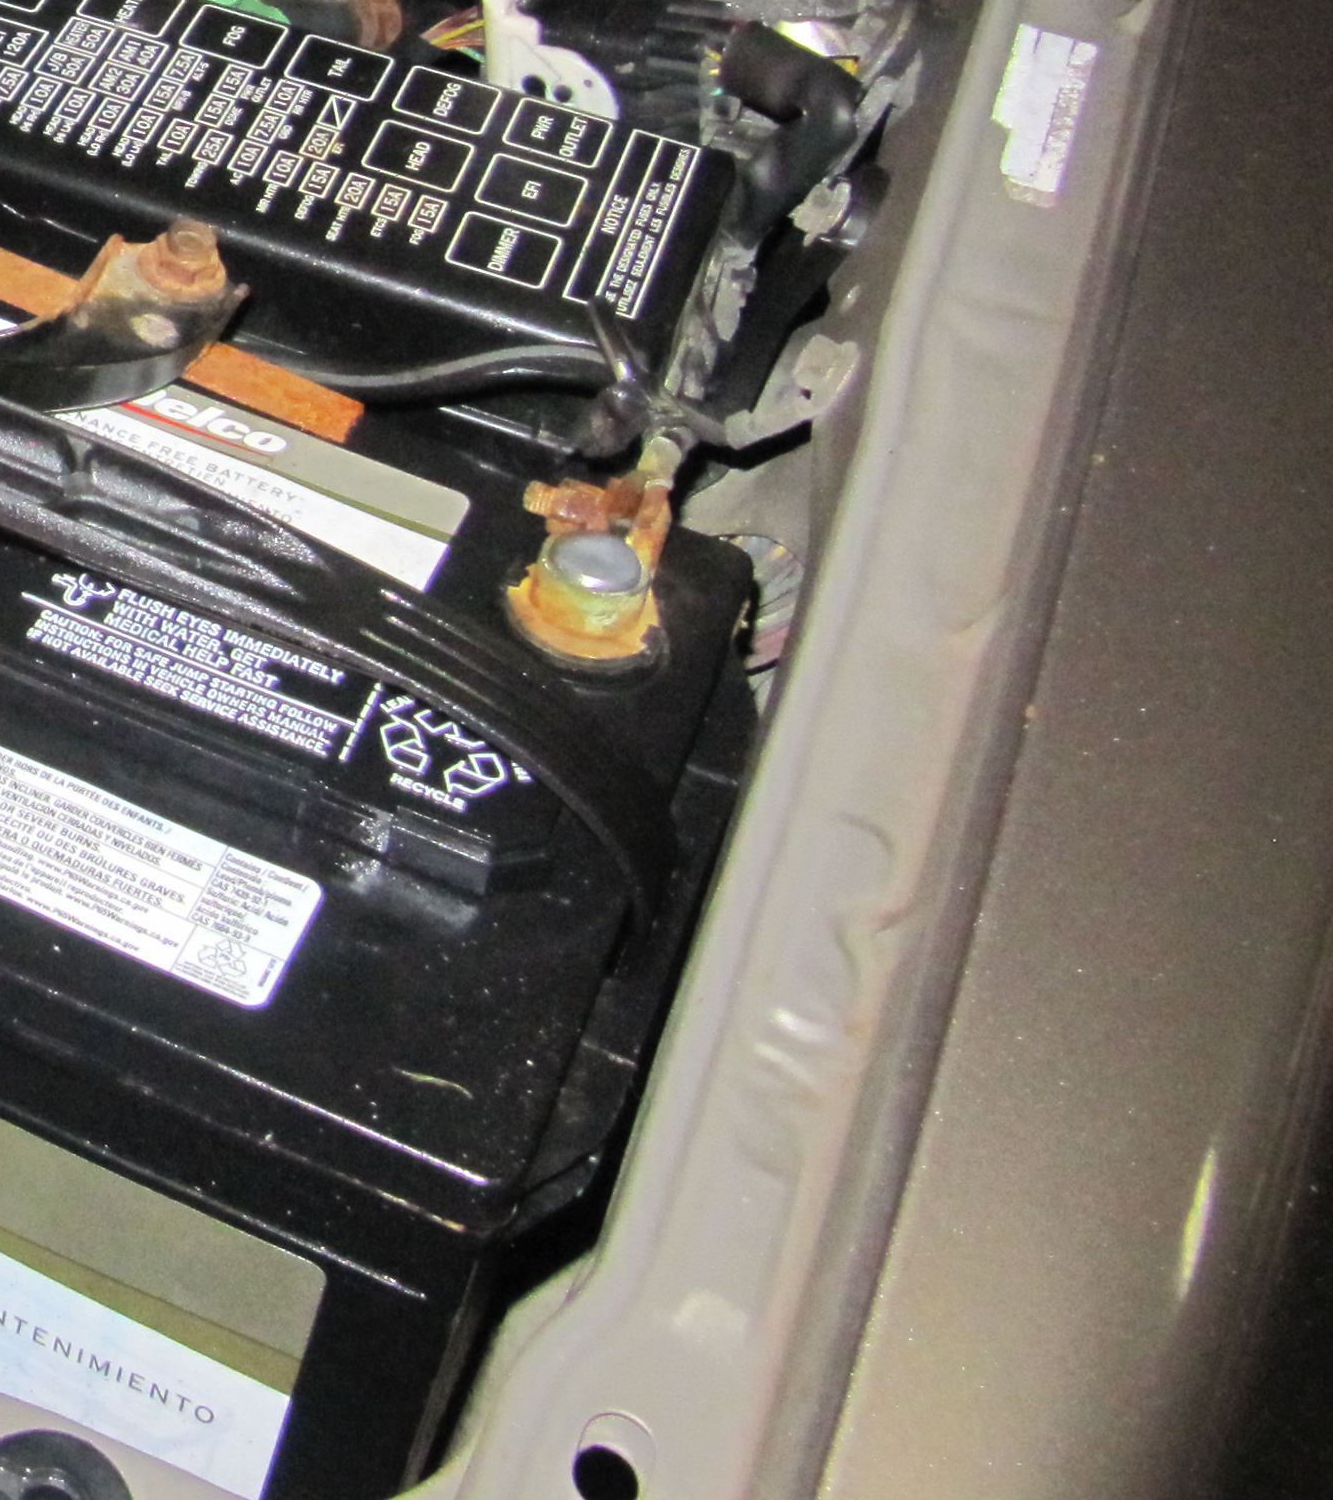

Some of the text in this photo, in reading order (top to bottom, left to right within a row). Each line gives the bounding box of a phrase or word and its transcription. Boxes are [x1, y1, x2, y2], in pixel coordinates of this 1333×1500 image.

[2, 30, 32, 57] 120A
[63, 20, 90, 46] HEATER
[80, 27, 106, 49] 50A
[221, 24, 246, 47] FOG
[46, 51, 68, 72] J/B
[117, 39, 142, 62] AM1
[136, 44, 160, 66] 40A
[60, 56, 86, 78] 50A
[168, 53, 196, 77] 7.5A
[326, 56, 352, 77] TAIL
[98, 66, 124, 91] AM2
[115, 72, 141, 95] 30A
[221, 70, 246, 91] 15A
[29, 82, 55, 104] 10A
[63, 92, 89, 114] 10A
[151, 83, 176, 104] 15A
[273, 85, 297, 106] 10A
[431, 81, 462, 117] DEFOG
[97, 103, 122, 124] 10A
[202, 99, 228, 120] 15A
[131, 114, 157, 135] 10A
[166, 124, 191, 146] 10A
[252, 114, 280, 137] 7.5A
[529, 114, 554, 140] PWR
[200, 135, 226, 159] 25A
[306, 131, 330, 154] 20A
[558, 115, 588, 158] OUTLET
[236, 146, 261, 167] 10A
[271, 156, 296, 178] 10A
[404, 140, 431, 171] HEAD
[307, 168, 332, 189] 15A
[520, 179, 542, 199] EFI
[342, 179, 368, 203] 20A
[379, 190, 404, 212] 15A
[293, 193, 317, 220] DEFOG
[416, 201, 440, 224] 15A
[599, 193, 629, 235] NOTICE
[369, 215, 388, 238] ETCS
[408, 227, 428, 245] FOG
[486, 226, 520, 272] DIMMER
[149, 440, 301, 503] FREE BATTERY
[111, 599, 268, 669] WITH WATER. GET
[116, 587, 344, 684] FLUSH EYES IMMEDIATELY
[102, 611, 278, 688] MEDICAL HELP FAST
[33, 618, 331, 745] INSTRUCTIONS IN VEHICLE OWNERS MANUAL.
[39, 608, 338, 733] CAUTION: FOR SAFE JUMP STARTING FOLLOW
[40, 632, 72, 652] NOT
[69, 646, 145, 683] AVAILABLE
[142, 674, 180, 697] SEEK
[178, 689, 239, 720] SERVICE
[236, 712, 327, 756] ASSISTANCE.
[389, 772, 466, 812] RECYCLE
[16, 808, 58, 832] SEVERE
[58, 826, 100, 852] BURNS.
[35, 829, 54, 843] OU
[53, 837, 78, 854] DES
[138, 877, 185, 903] GRAVES.
